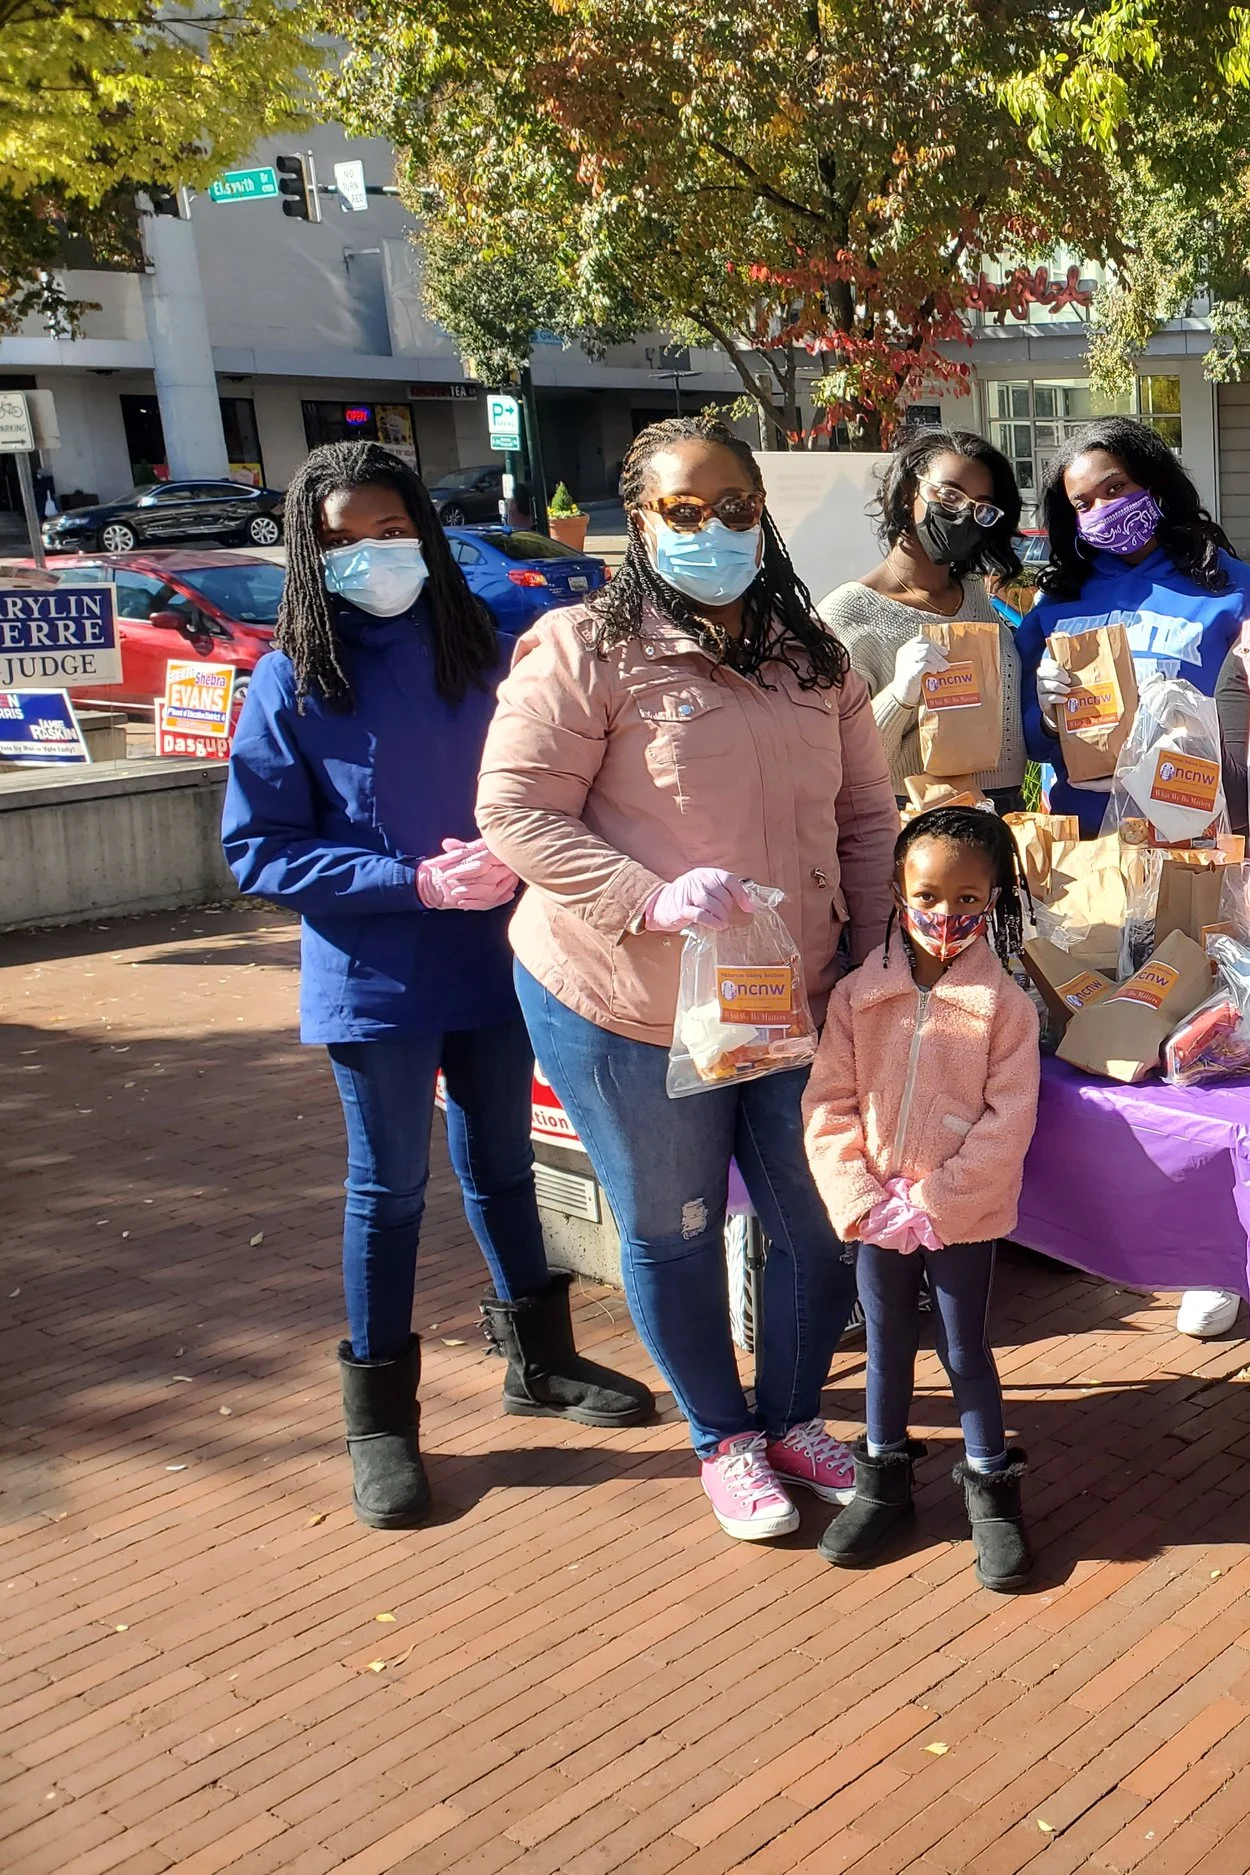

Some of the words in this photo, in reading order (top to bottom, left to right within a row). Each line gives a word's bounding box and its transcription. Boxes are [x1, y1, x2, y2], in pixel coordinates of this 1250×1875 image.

[450, 386, 467, 397] TEA
[346, 410, 367, 422] OPEN
[3, 654, 97, 686] JUDGE
[195, 671, 226, 687] Shebra
[939, 674, 972, 686] ncnw
[171, 685, 225, 711] EVANS
[1079, 694, 1112, 707] ncnw
[39, 718, 66, 730] JAMIE
[29, 724, 78, 740] RASKIN
[1175, 767, 1215, 785] ncnw
[1155, 789, 1170, 798] What
[1171, 792, 1180, 801] We
[1181, 794, 1190, 803] Do
[1191, 796, 1211, 808] Matters
[737, 983, 786, 996] ncnw
[1128, 989, 1137, 997] Do
[1139, 991, 1158, 1004] Matters
[724, 1010, 739, 1019] What
[740, 1012, 749, 1021] We
[751, 1012, 760, 1021] Do
[762, 1013, 786, 1021] Matters
[532, 1111, 570, 1130] tion
